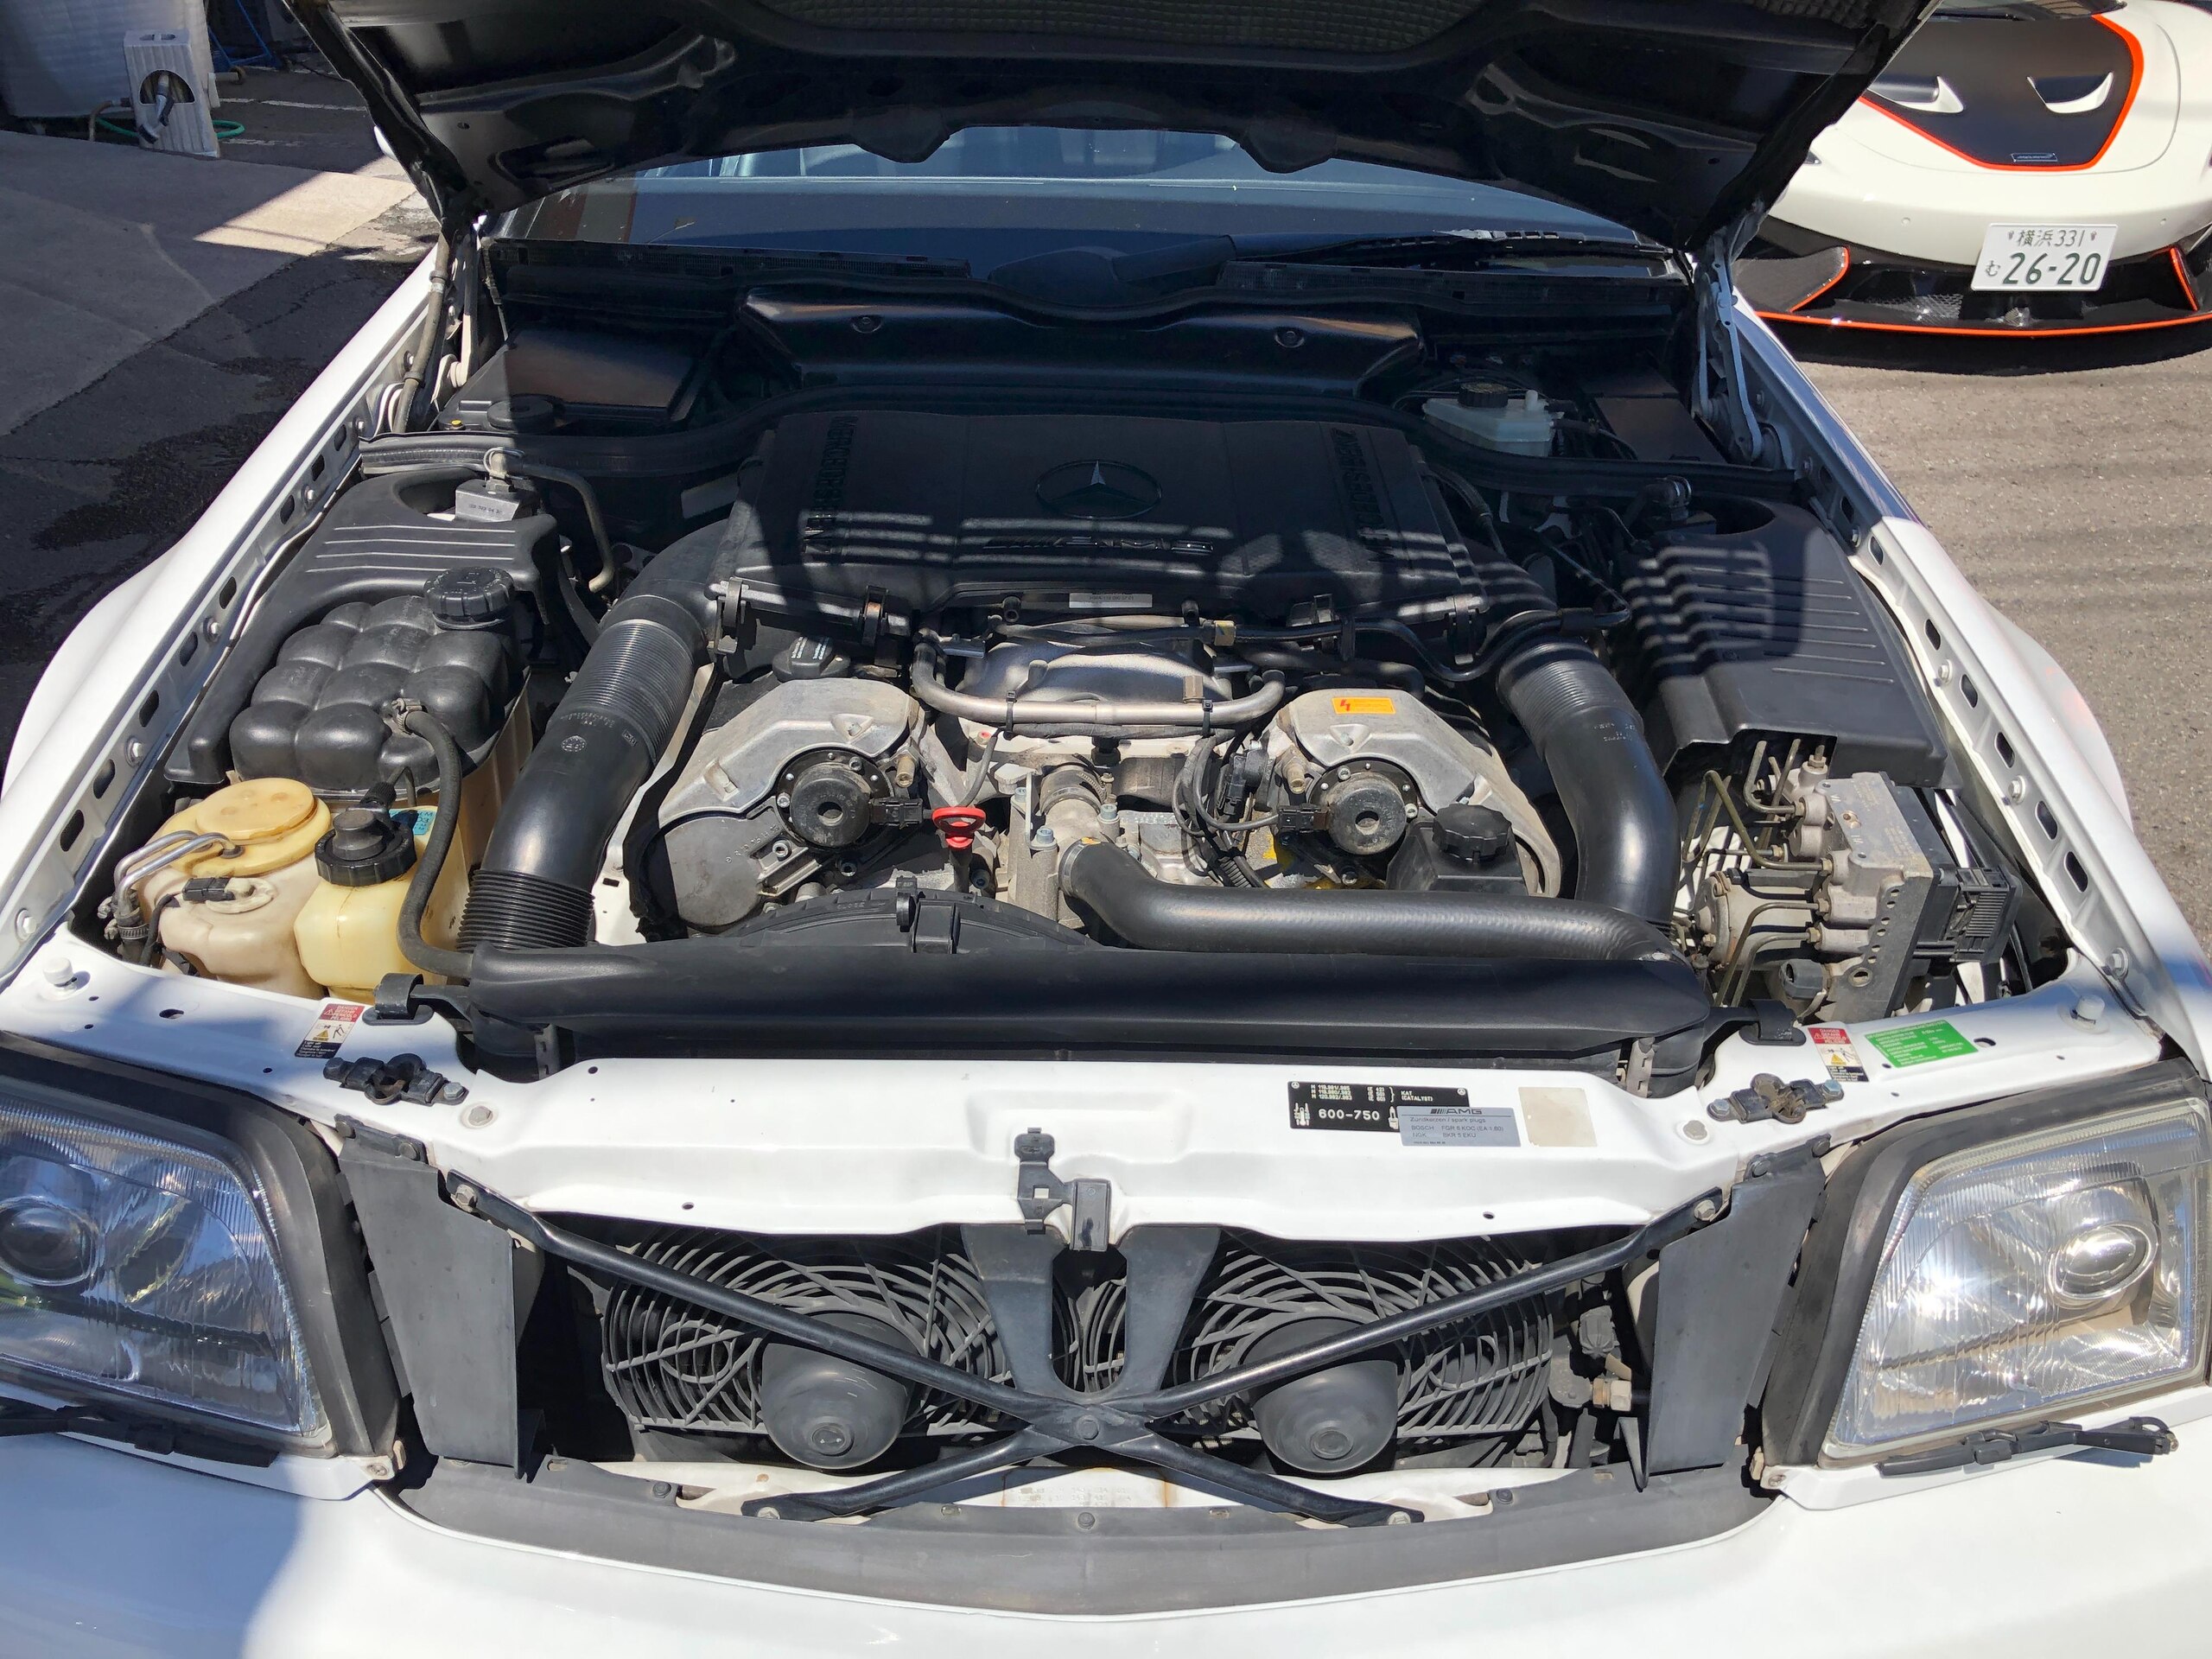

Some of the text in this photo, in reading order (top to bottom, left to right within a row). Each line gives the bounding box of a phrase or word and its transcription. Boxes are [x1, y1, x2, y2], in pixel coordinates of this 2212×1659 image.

[1985, 252, 2101, 285] む 26-20
[1318, 1108, 1380, 1121] 600-750
